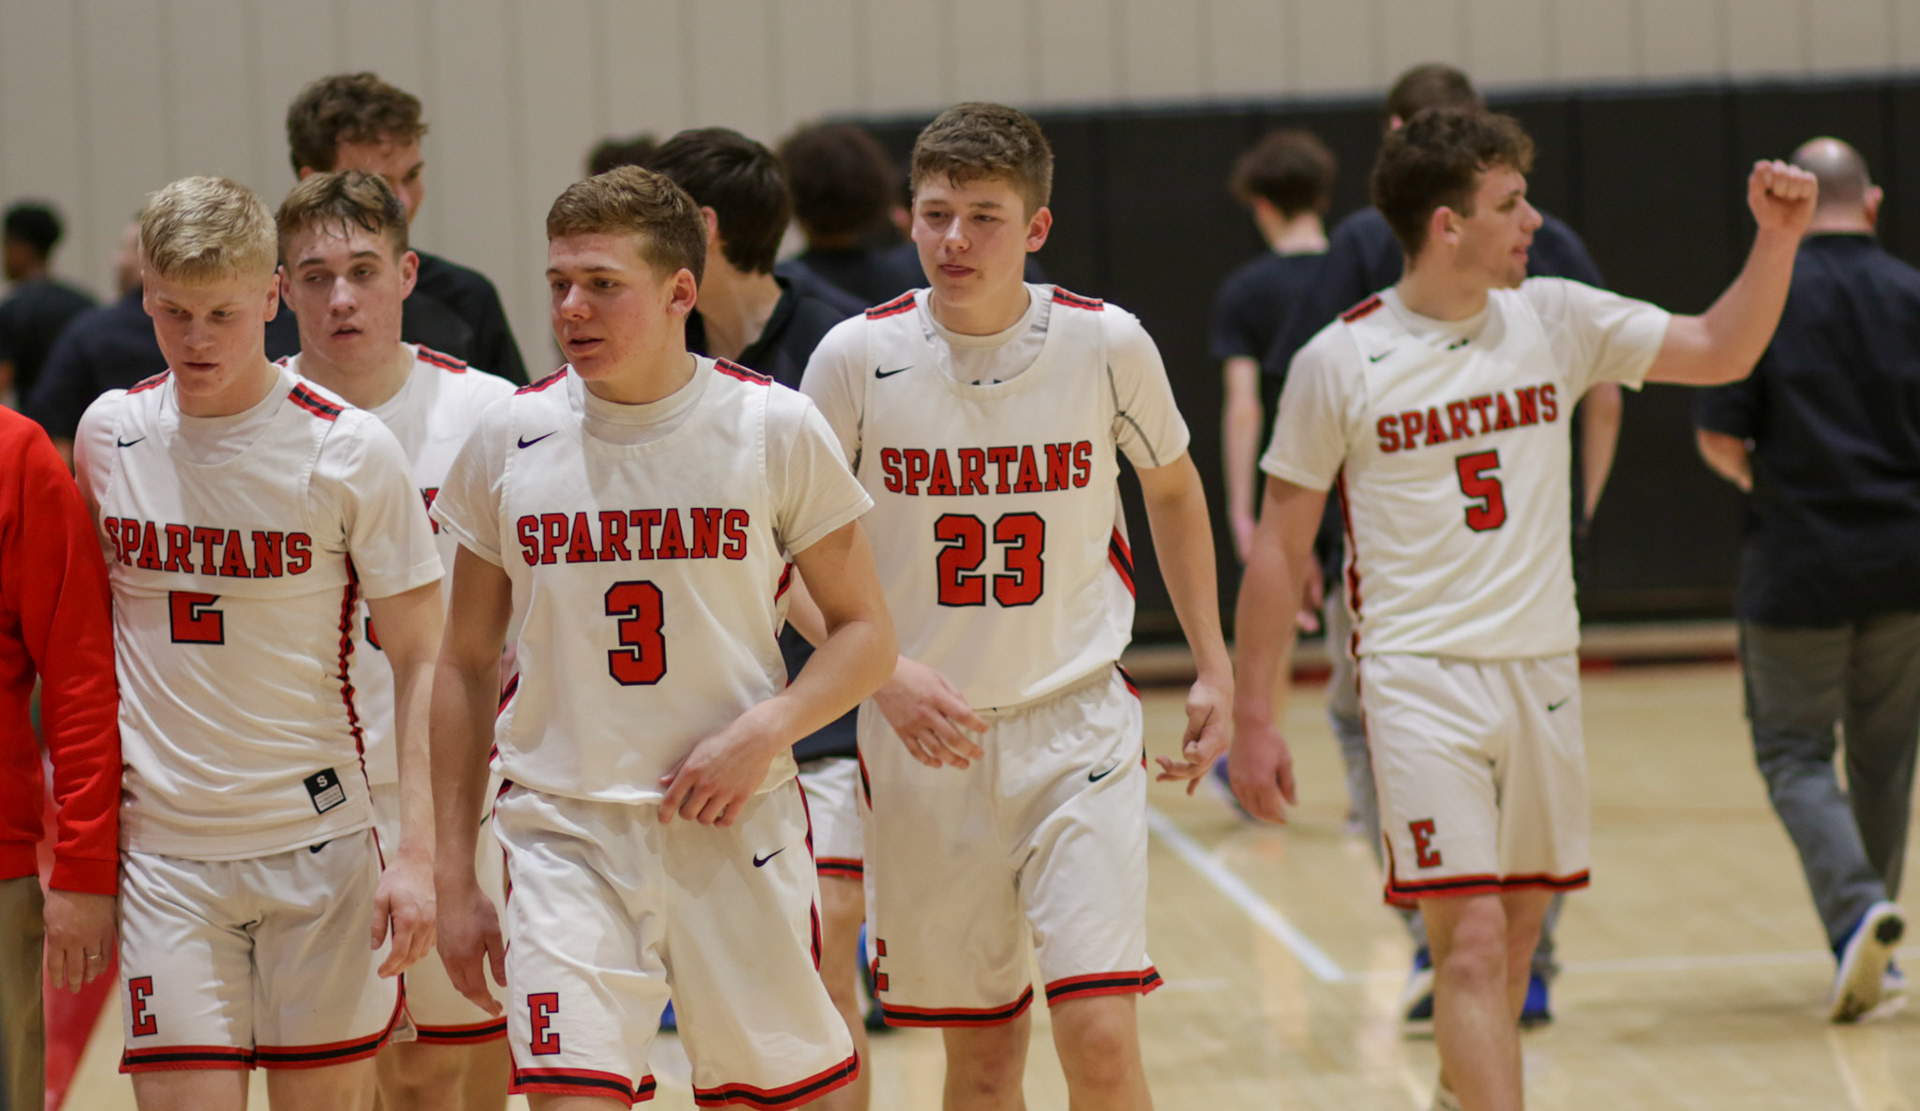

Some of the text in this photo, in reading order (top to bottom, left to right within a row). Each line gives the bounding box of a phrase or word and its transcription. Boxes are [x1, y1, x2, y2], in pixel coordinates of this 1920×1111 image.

[1377, 383, 1557, 453] SPARTANS
[880, 440, 1092, 496] SPARTANS
[1455, 449, 1507, 532] 5
[104, 516, 312, 578] SPARTANS
[517, 507, 750, 566] SPARTANS
[934, 511, 1046, 608] 23
[605, 580, 667, 686] 3
[1408, 819, 1442, 869] E
[128, 975, 158, 1038] E
[527, 992, 561, 1056] E
